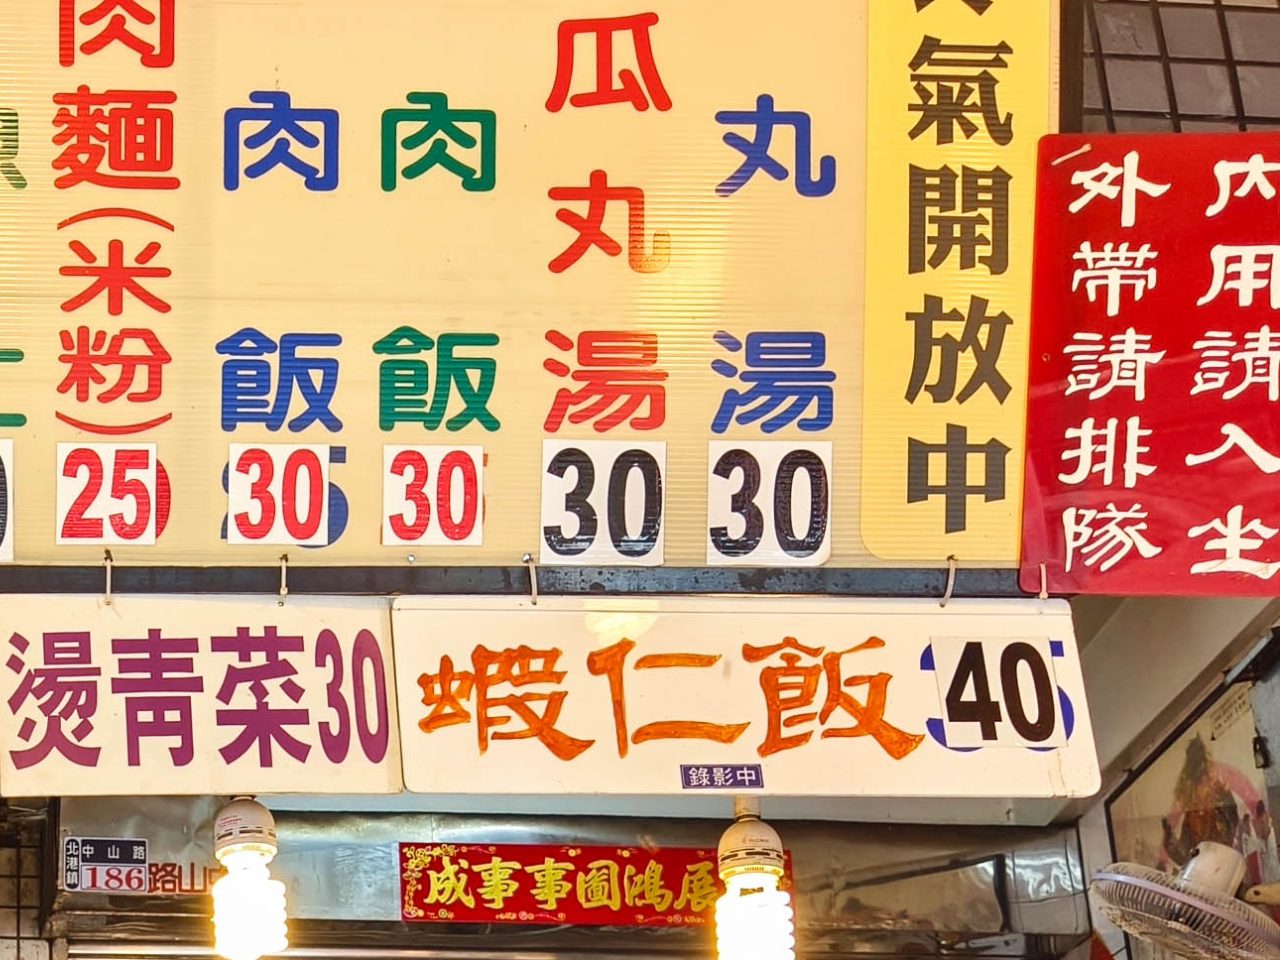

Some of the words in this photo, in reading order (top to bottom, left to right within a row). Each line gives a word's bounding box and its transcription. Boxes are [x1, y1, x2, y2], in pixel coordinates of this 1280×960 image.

[215, 90, 343, 432] 肉飯
[372, 91, 500, 432] 肉飯
[543, 12, 672, 433] 瓜丸湯
[711, 94, 836, 433] 丸湯
[1058, 150, 1171, 573] 外帶請排隊
[62, 448, 151, 540] 25
[234, 449, 320, 540] 30
[390, 450, 477, 540] 30
[544, 449, 661, 557] 30
[709, 450, 828, 558] 30
[417, 636, 926, 761] 蝦仁飯
[945, 642, 1055, 741] 40
[689, 767, 756, 786] 錄影中
[66, 841, 79, 885] 北港鎮
[82, 845, 145, 860] 中山路
[86, 867, 144, 890] 186
